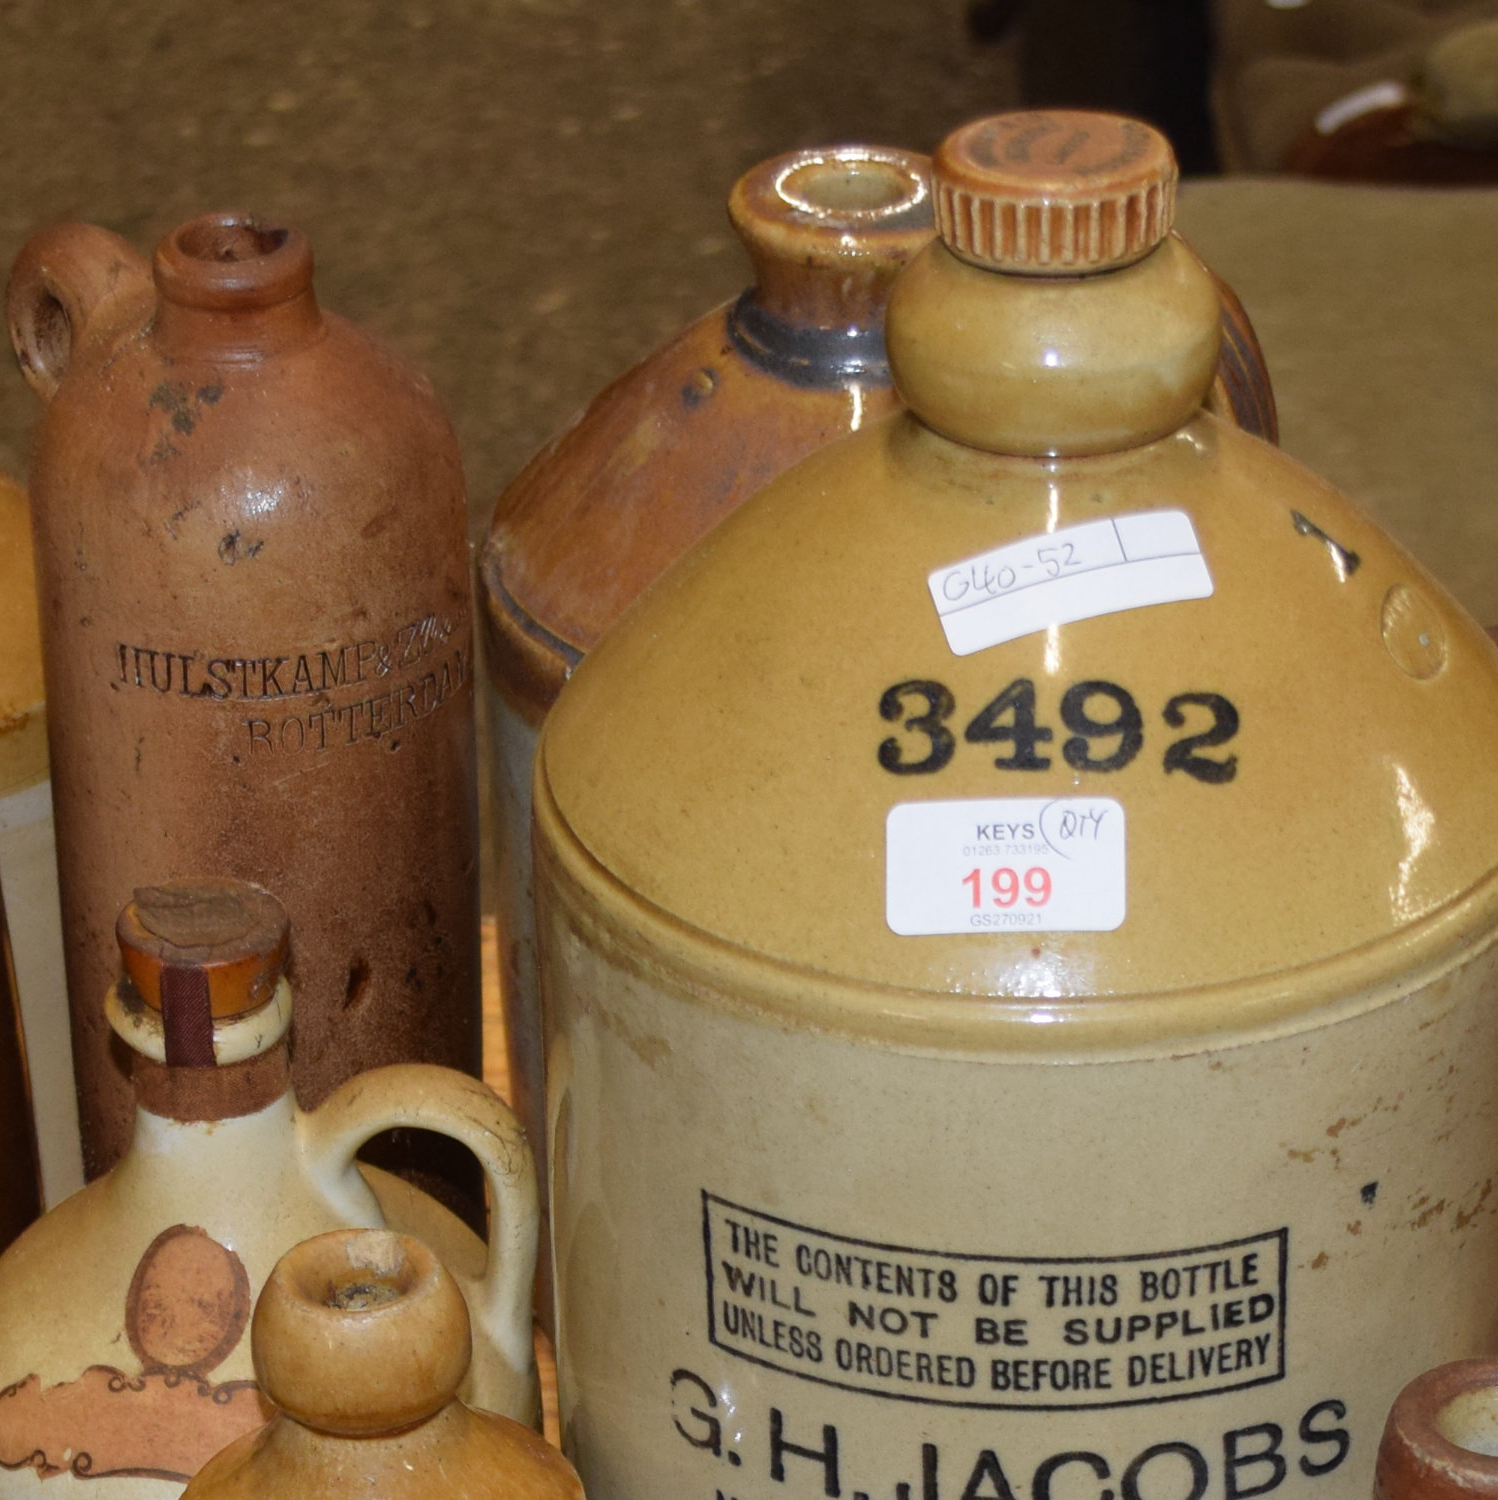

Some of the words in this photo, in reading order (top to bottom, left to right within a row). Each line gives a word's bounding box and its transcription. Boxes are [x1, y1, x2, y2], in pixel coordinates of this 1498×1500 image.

[877, 678, 1240, 784] 3492
[962, 845, 1001, 857] 01263
[976, 823, 1035, 840] KEYS
[962, 866, 1053, 909] 199
[970, 913, 1042, 927] GS270921
[725, 1218, 780, 1268] THE
[796, 1244, 958, 1304] CONTENTS
[978, 1273, 1020, 1307] OF
[1039, 1273, 1118, 1308] THIS
[1140, 1252, 1259, 1303] BOTTLE
[722, 1260, 817, 1318] WILL
[848, 1301, 939, 1339] NOT
[975, 1317, 1029, 1346] BE
[1063, 1293, 1275, 1346] SUPPLIED
[723, 1300, 823, 1363] UNLESS
[836, 1338, 977, 1389] ORDERED
[991, 1358, 1112, 1391] BEFORE
[1128, 1332, 1272, 1388] DELIVERY
